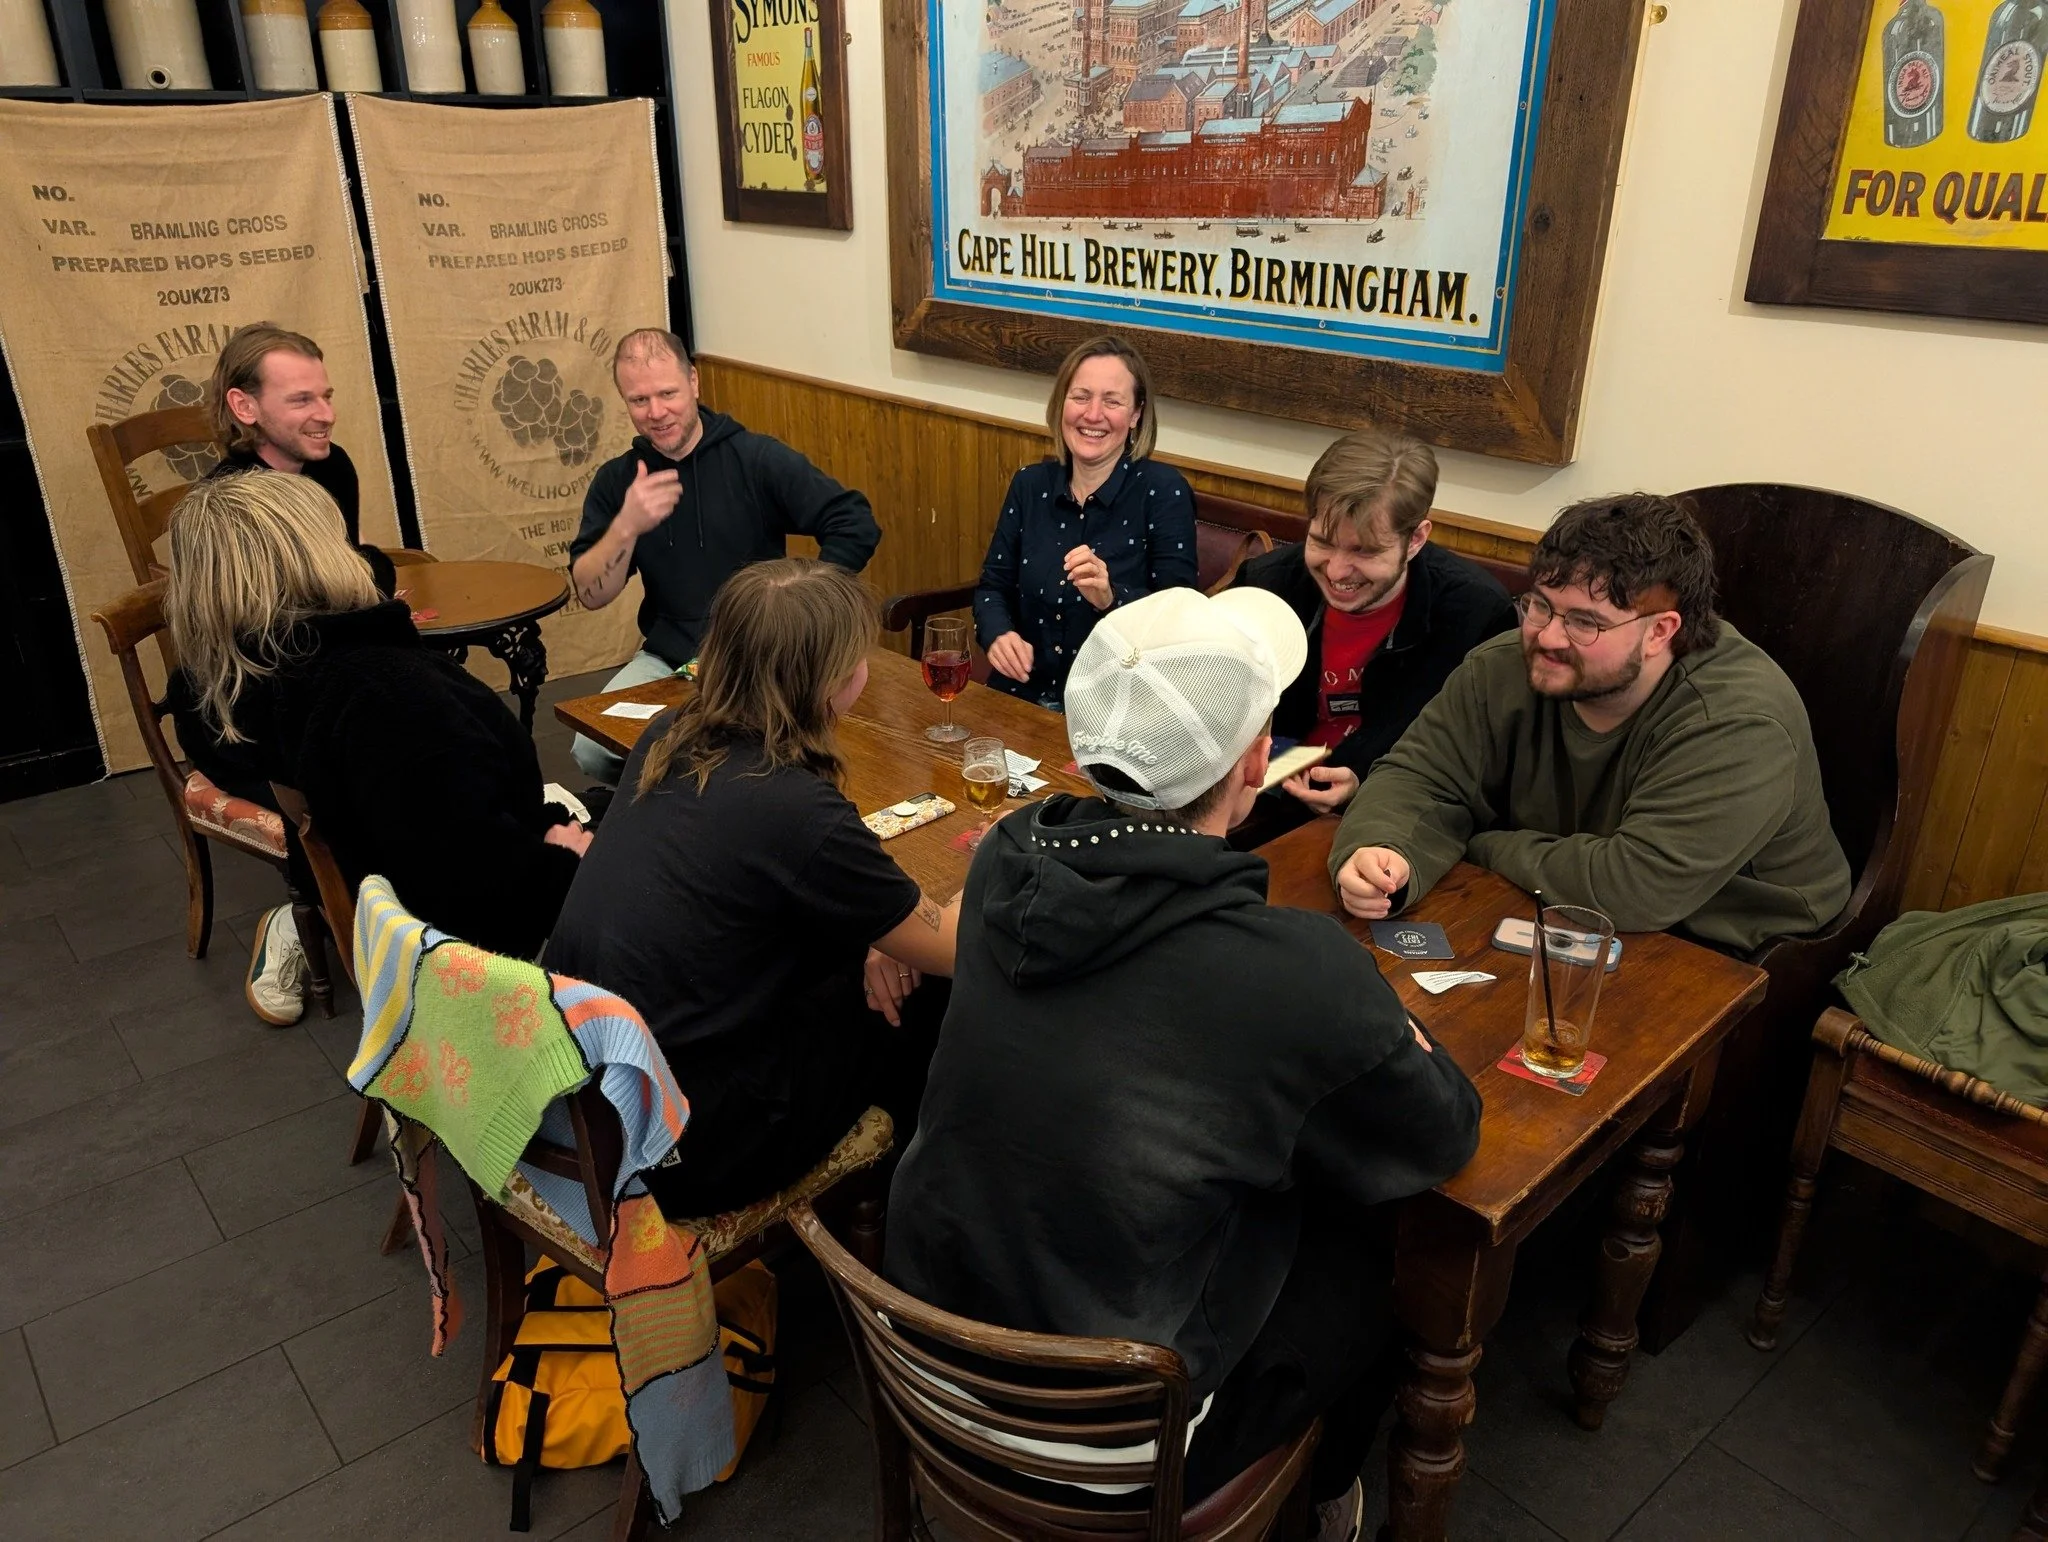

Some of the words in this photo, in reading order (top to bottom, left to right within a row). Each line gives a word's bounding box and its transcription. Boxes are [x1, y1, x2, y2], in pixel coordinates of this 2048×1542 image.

[747, 52, 781, 67] FAMOUS
[743, 86, 789, 109] FLAGON
[743, 122, 796, 153] CYDER
[32, 185, 75, 202] NO.
[418, 193, 450, 208] NO.
[1842, 169, 1927, 218] FOR
[1932, 171, 2048, 225] QUAL
[42, 219, 96, 236] VAR.
[130, 220, 220, 241] BRAMLING
[226, 215, 288, 235] CROSS
[422, 222, 466, 237] VAR.
[490, 219, 557, 240] BRAMLING
[562, 212, 608, 231] CROSS
[51, 256, 169, 273] PREPARED
[175, 252, 233, 271] HOPS
[239, 244, 315, 267] SEEDED
[428, 252, 518, 269] PREPARED
[523, 243, 566, 263] HOPS
[570, 237, 628, 259] SEEDED
[957, 228, 1015, 276] CAPE
[1021, 233, 1077, 283] HILL
[1229, 247, 1480, 325] BIRMINGHAM.
[453, 329, 511, 412] CHARLES
[505, 310, 569, 345] FARAM
[573, 317, 588, 344] &
[94, 342, 164, 426] HARLES
[518, 522, 546, 541] THE
